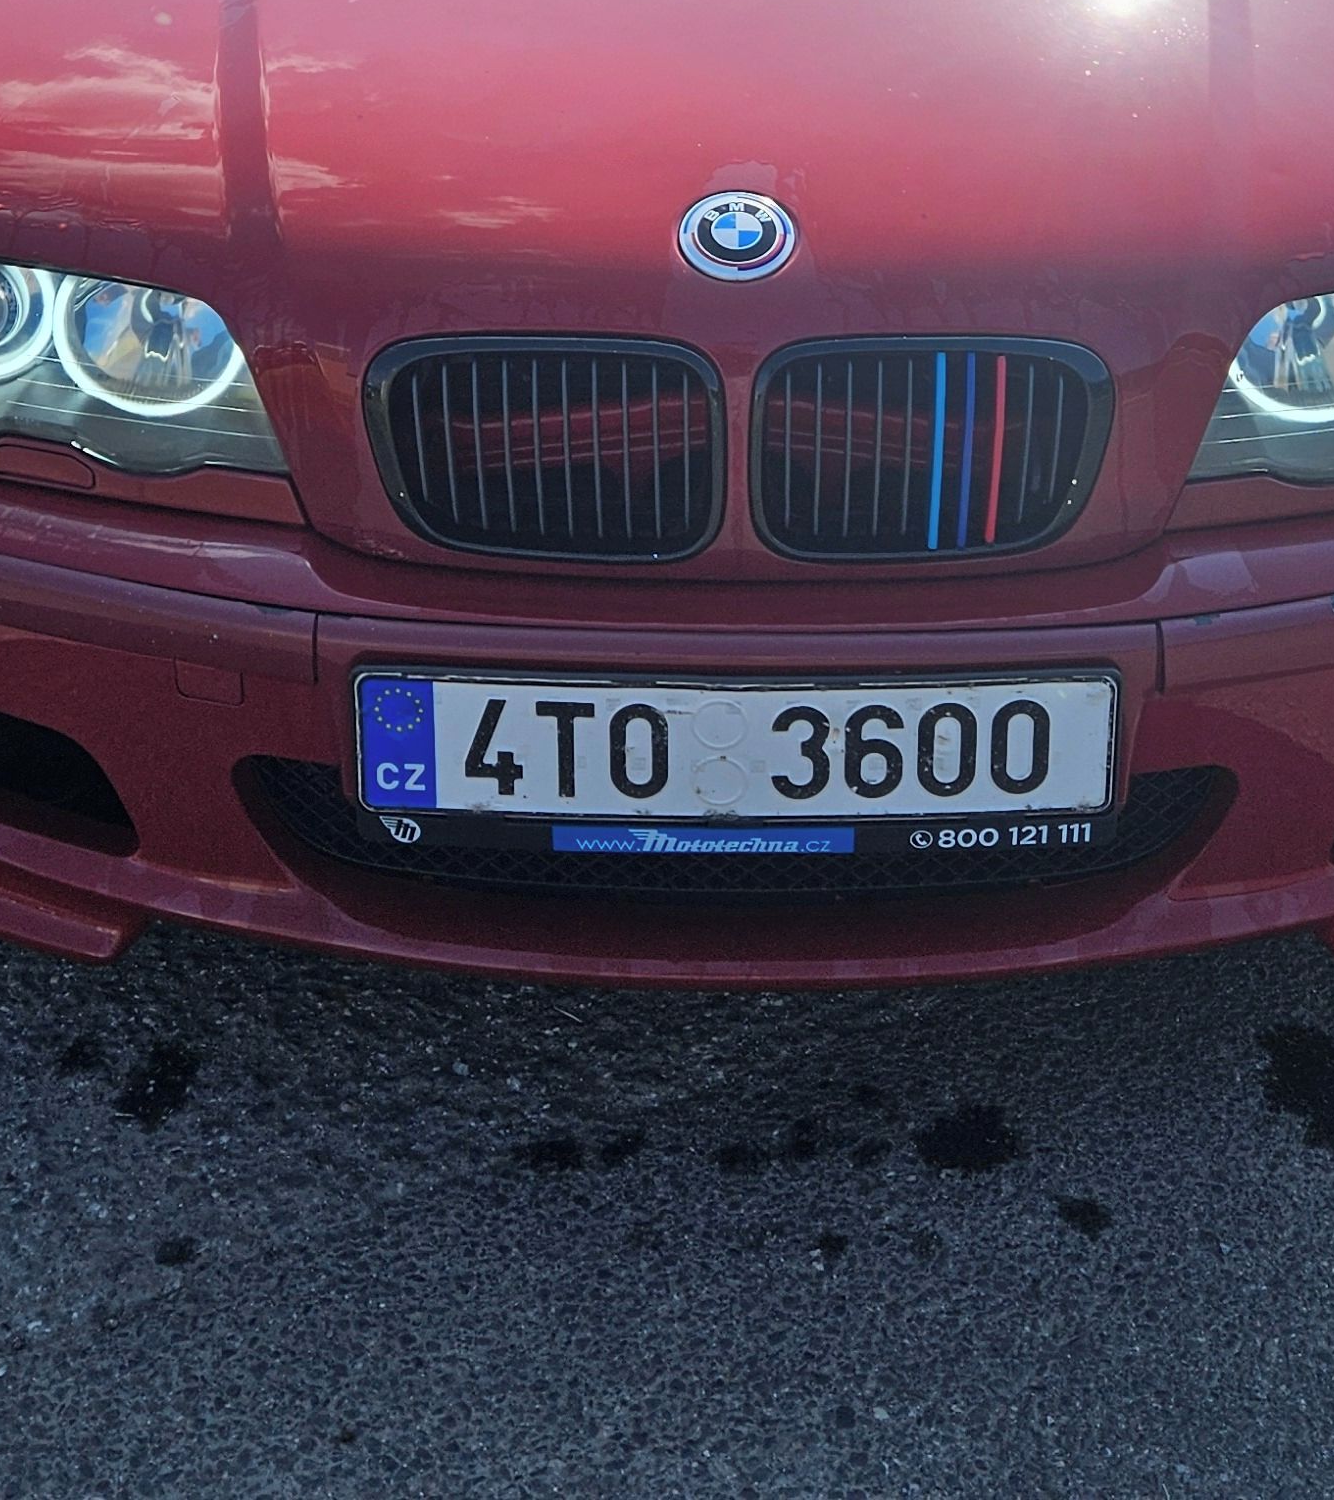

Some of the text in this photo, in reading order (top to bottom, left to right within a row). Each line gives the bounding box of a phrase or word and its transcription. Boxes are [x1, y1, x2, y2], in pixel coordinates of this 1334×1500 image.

[703, 202, 772, 223] BMW
[771, 698, 1050, 800] 3600
[375, 762, 427, 791] CZ
[576, 828, 832, 854] www.Mototechna.cz
[938, 823, 1092, 849] 800 121 111
